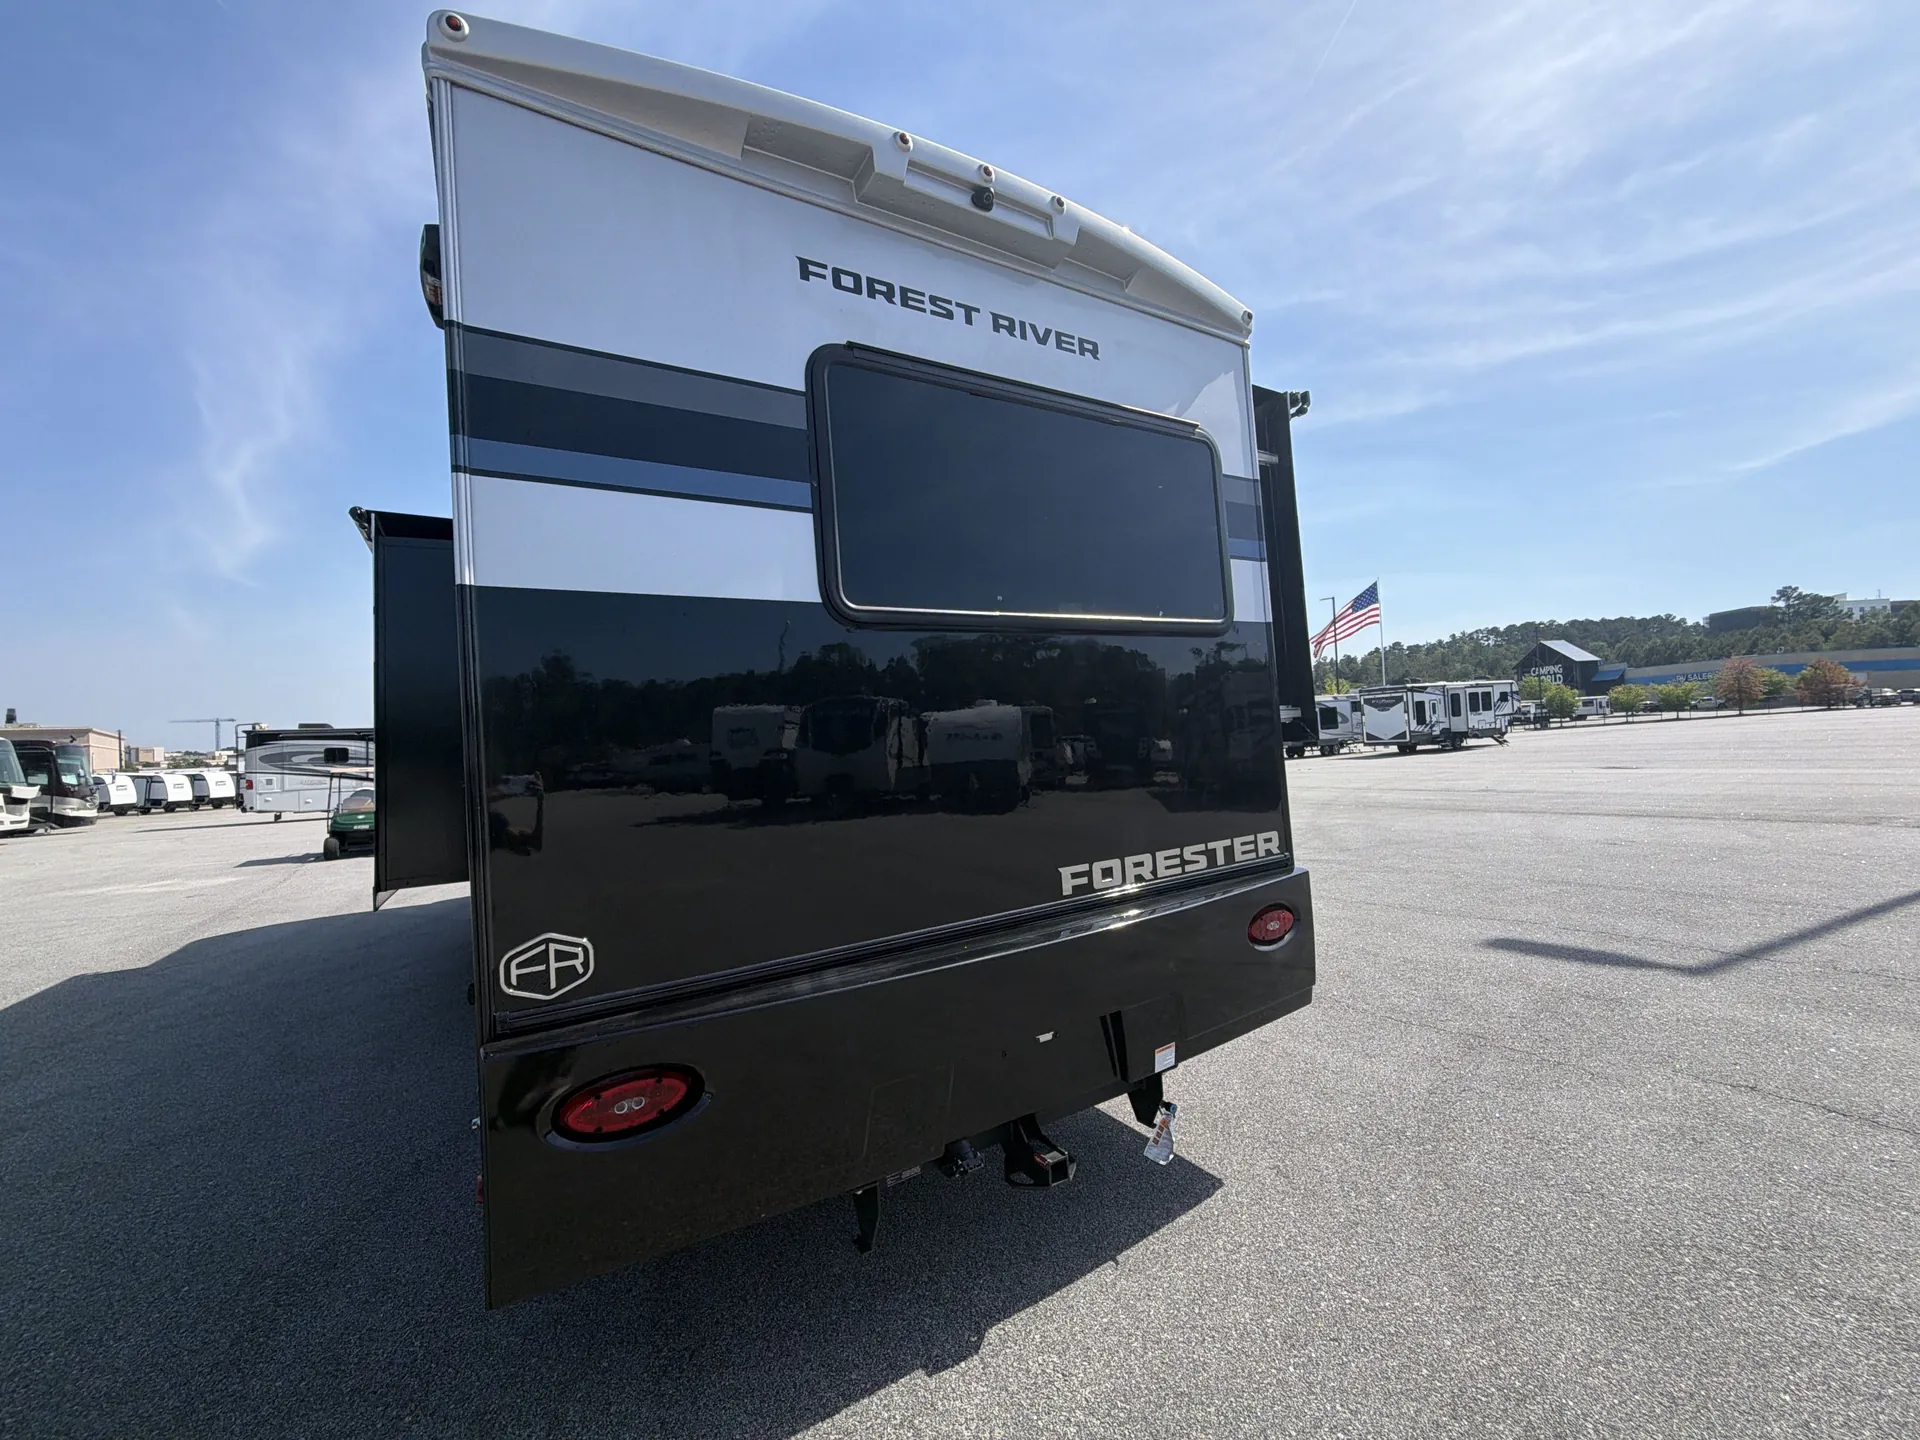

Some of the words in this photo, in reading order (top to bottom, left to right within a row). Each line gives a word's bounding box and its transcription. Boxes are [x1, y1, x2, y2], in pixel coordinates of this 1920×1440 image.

[795, 255, 980, 326] FOREST
[989, 311, 1100, 361] RIVER
[1057, 830, 1281, 896] FORESTER
[510, 942, 584, 990] FR
